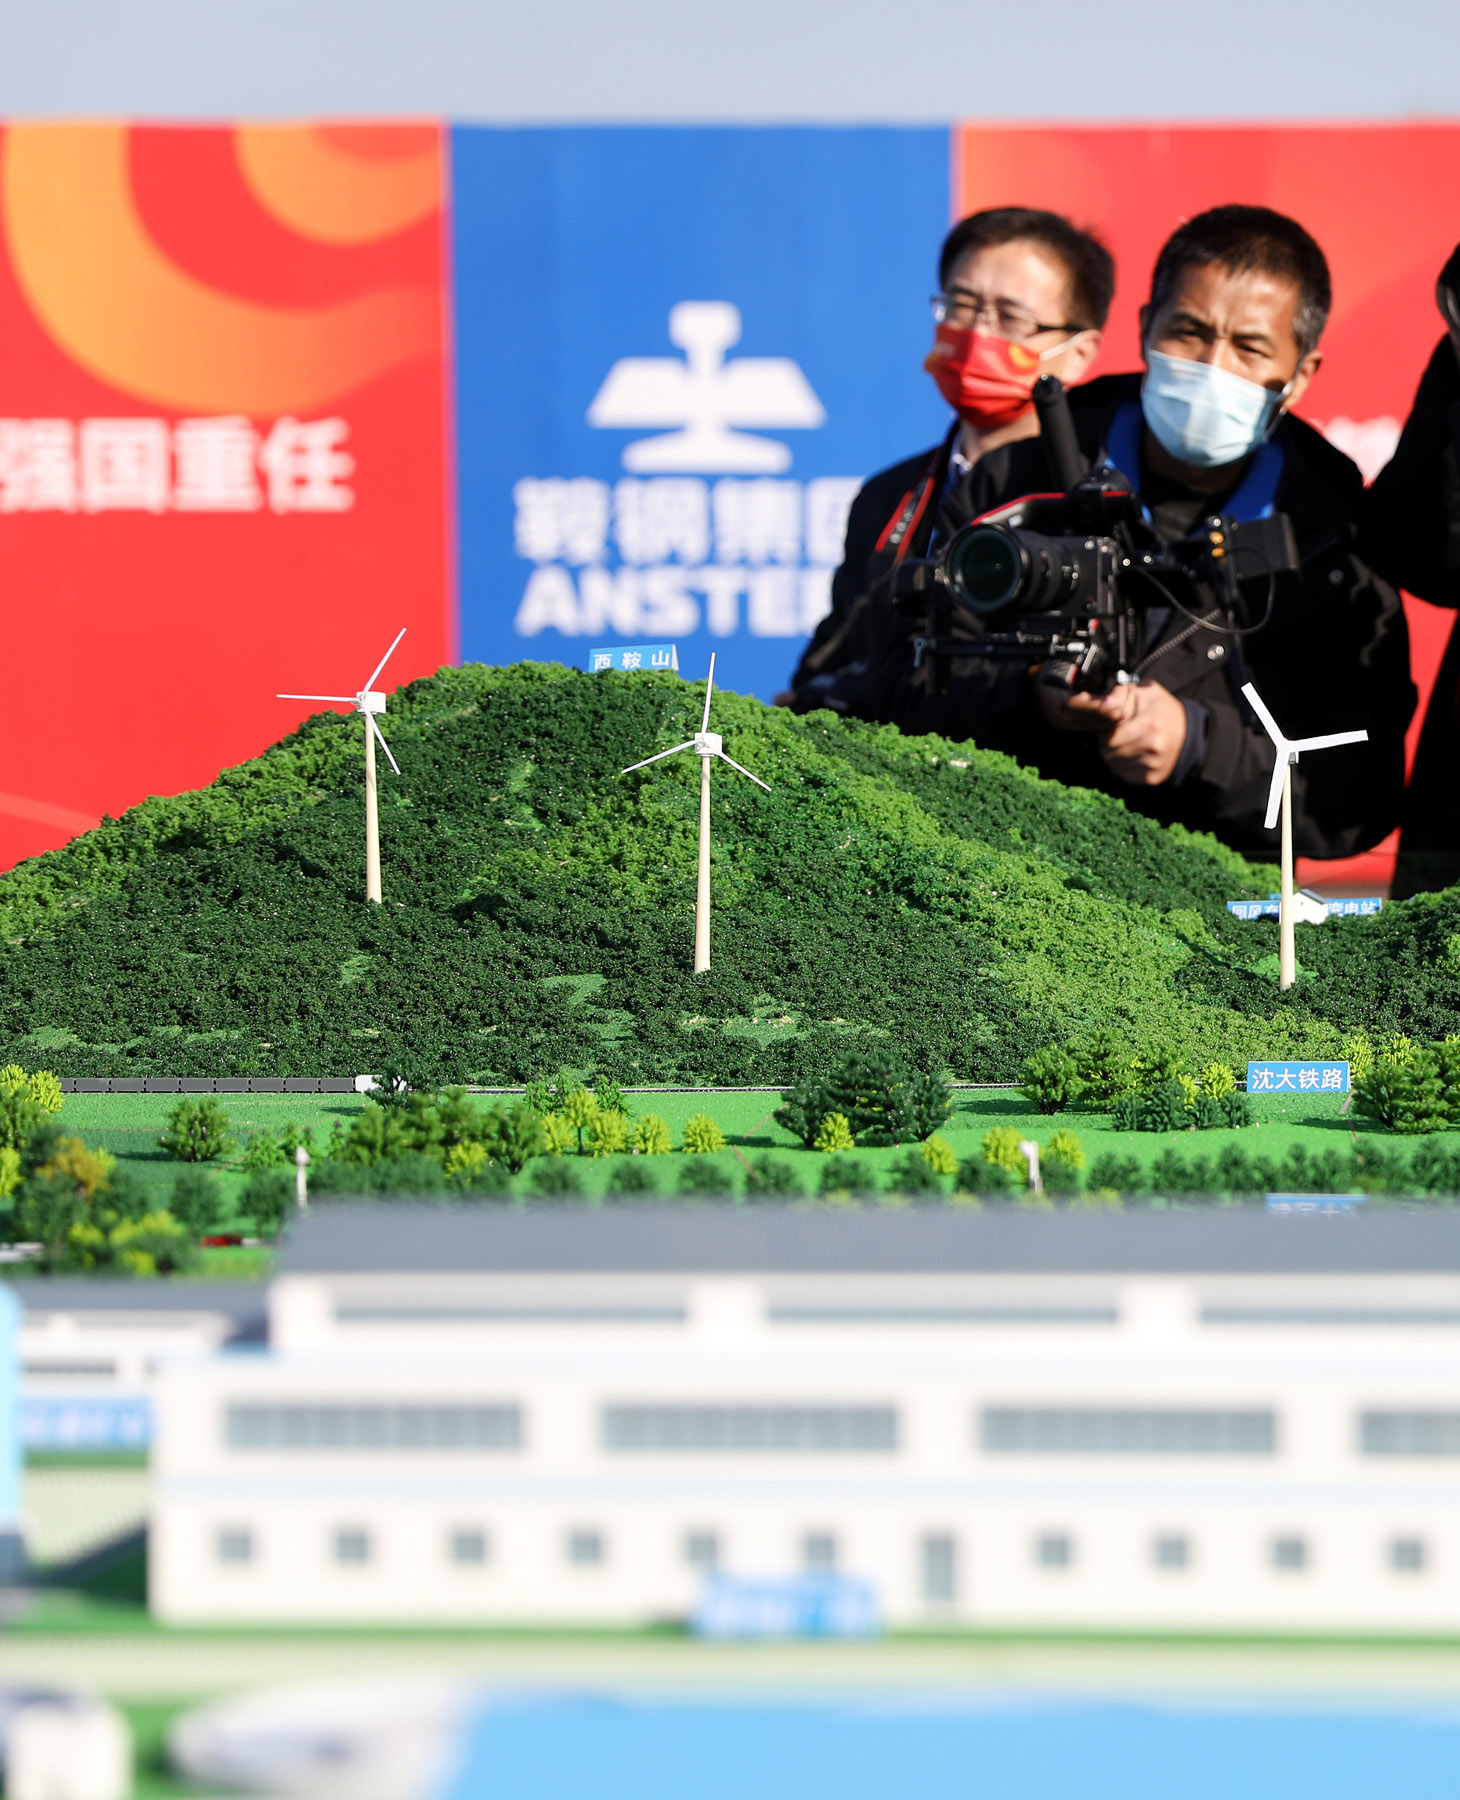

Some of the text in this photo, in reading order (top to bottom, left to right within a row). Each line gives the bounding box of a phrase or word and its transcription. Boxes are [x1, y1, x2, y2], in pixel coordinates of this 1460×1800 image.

[593, 650, 670, 670] 西鞍山
[1252, 1068, 1343, 1090] 沈大铁路
